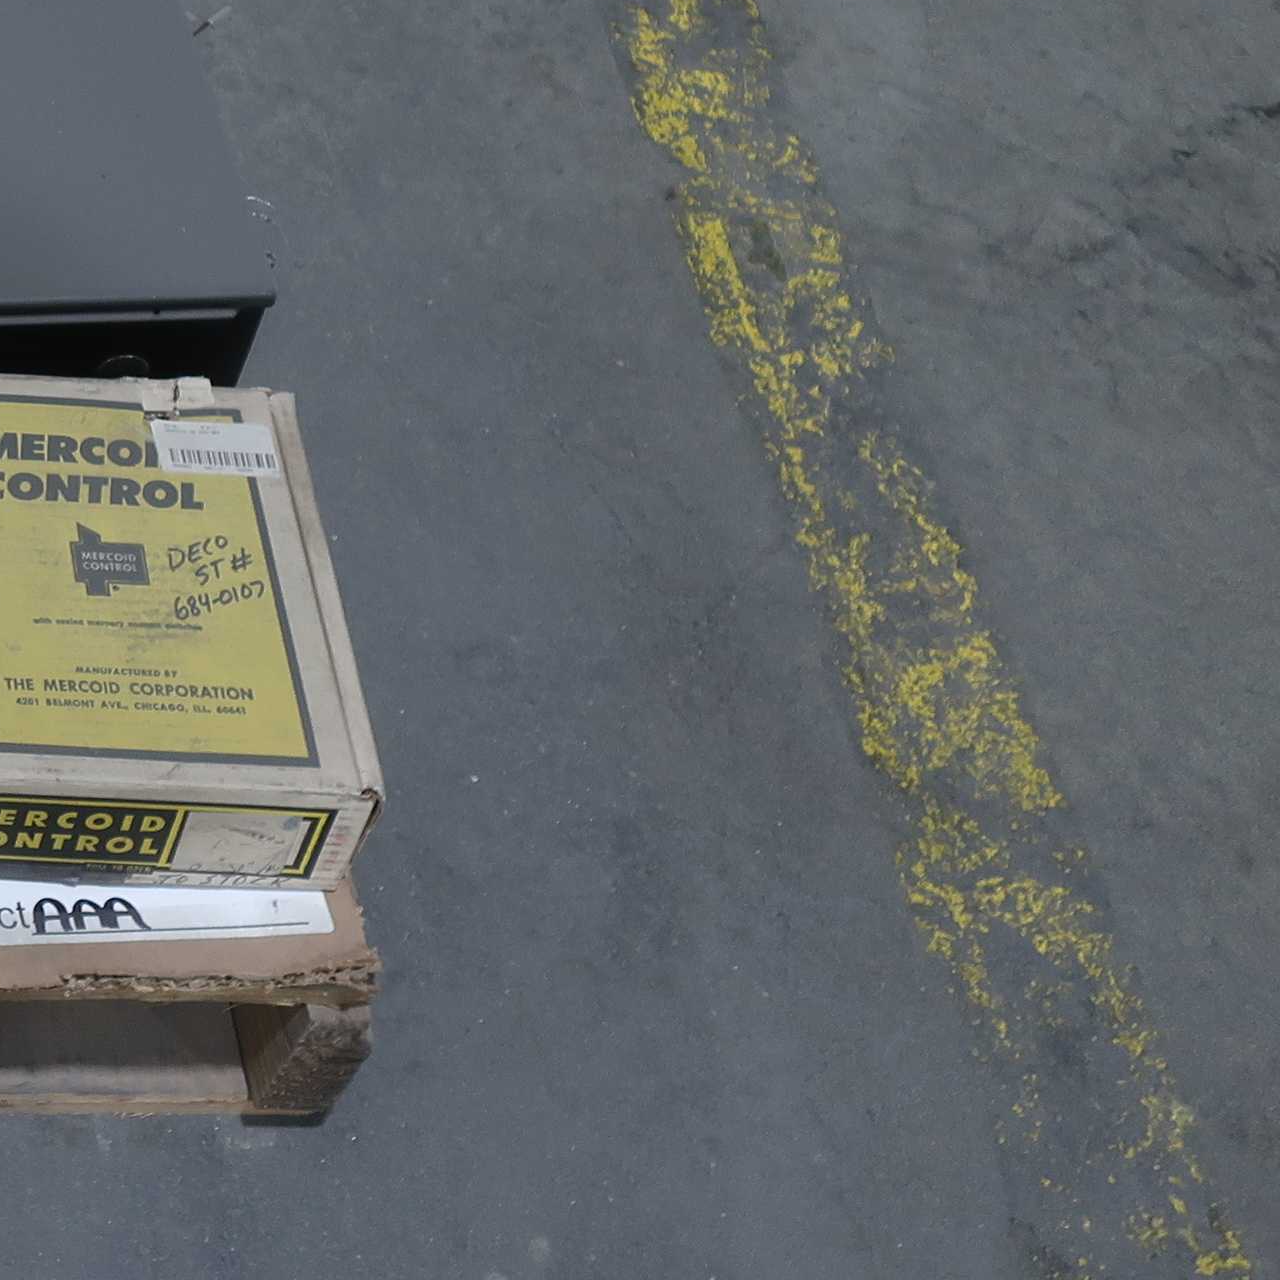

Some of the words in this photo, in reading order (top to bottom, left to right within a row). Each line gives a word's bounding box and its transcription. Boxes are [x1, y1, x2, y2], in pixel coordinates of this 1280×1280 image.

[81, 551, 136, 563] MERCOID
[168, 534, 228, 570] DECO
[231, 548, 253, 571] #
[82, 561, 137, 572] CONTROL
[173, 580, 265, 620] 684-0107
[75, 666, 162, 677] MANUFACTURED
[164, 670, 178, 678] BY
[4, 678, 35, 692] THE
[43, 679, 121, 695] MERCOID
[130, 682, 255, 701] CORPORATION
[15, 697, 40, 707] 4201
[45, 698, 96, 710] BELMONT
[134, 701, 189, 714] CHICAGO,
